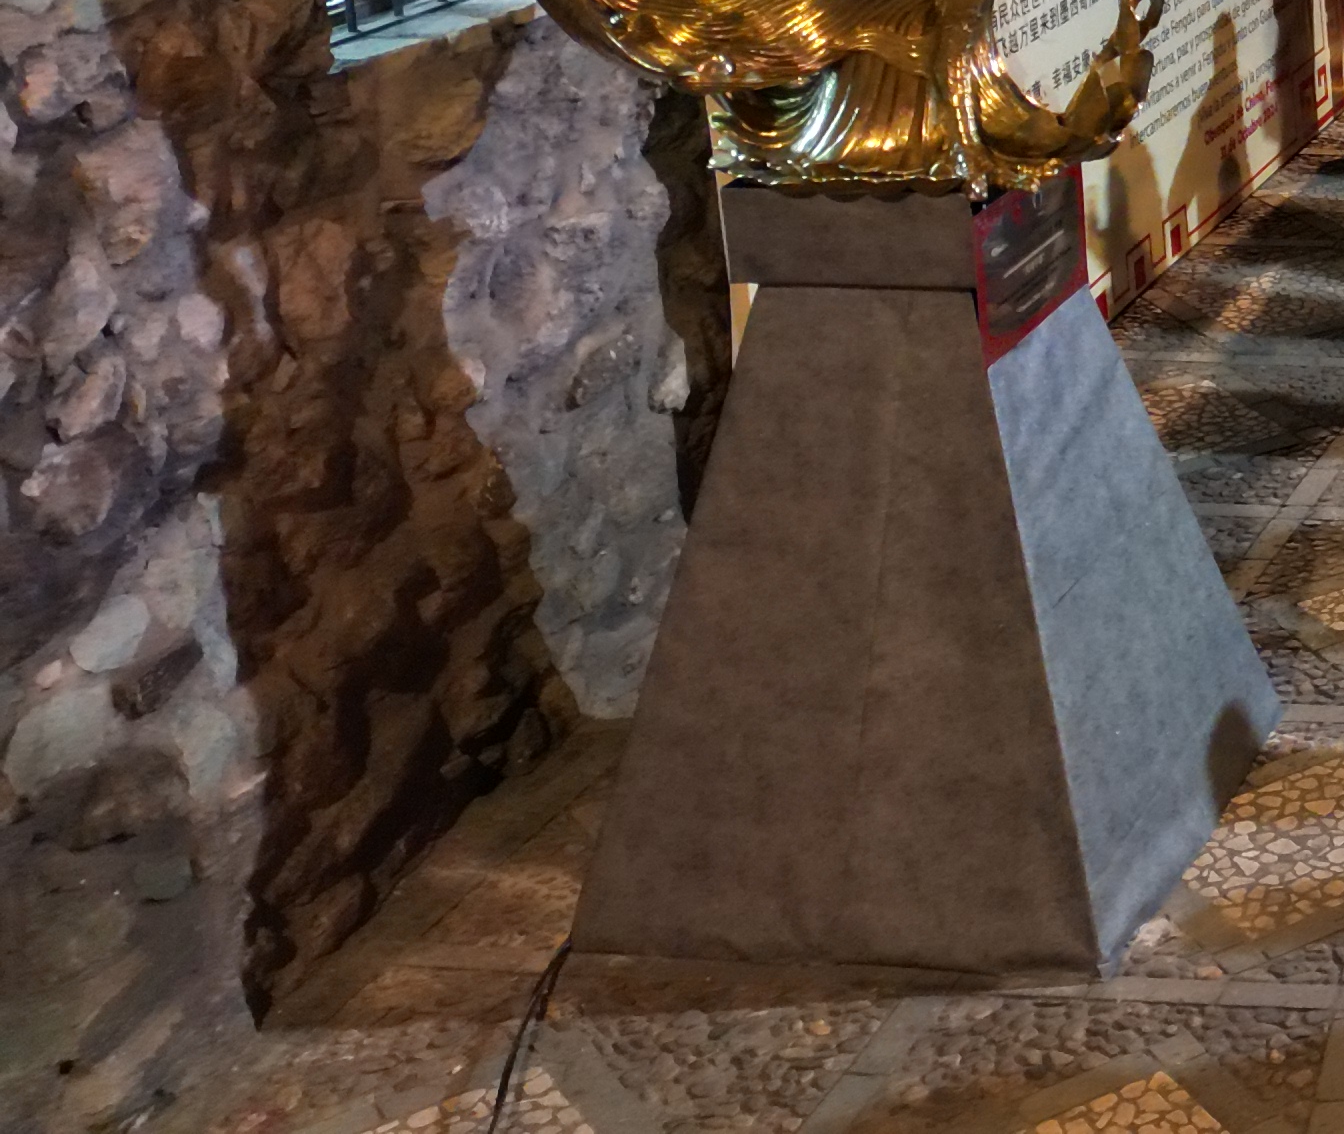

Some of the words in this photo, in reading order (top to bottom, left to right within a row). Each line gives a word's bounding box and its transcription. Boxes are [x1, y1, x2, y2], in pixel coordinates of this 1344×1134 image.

[1160, 28, 1170, 42] de
[1170, 9, 1195, 33] Fengdu
[1248, 17, 1259, 33] con
[1151, 53, 1174, 76] ortuna,
[1176, 42, 1189, 61] paz
